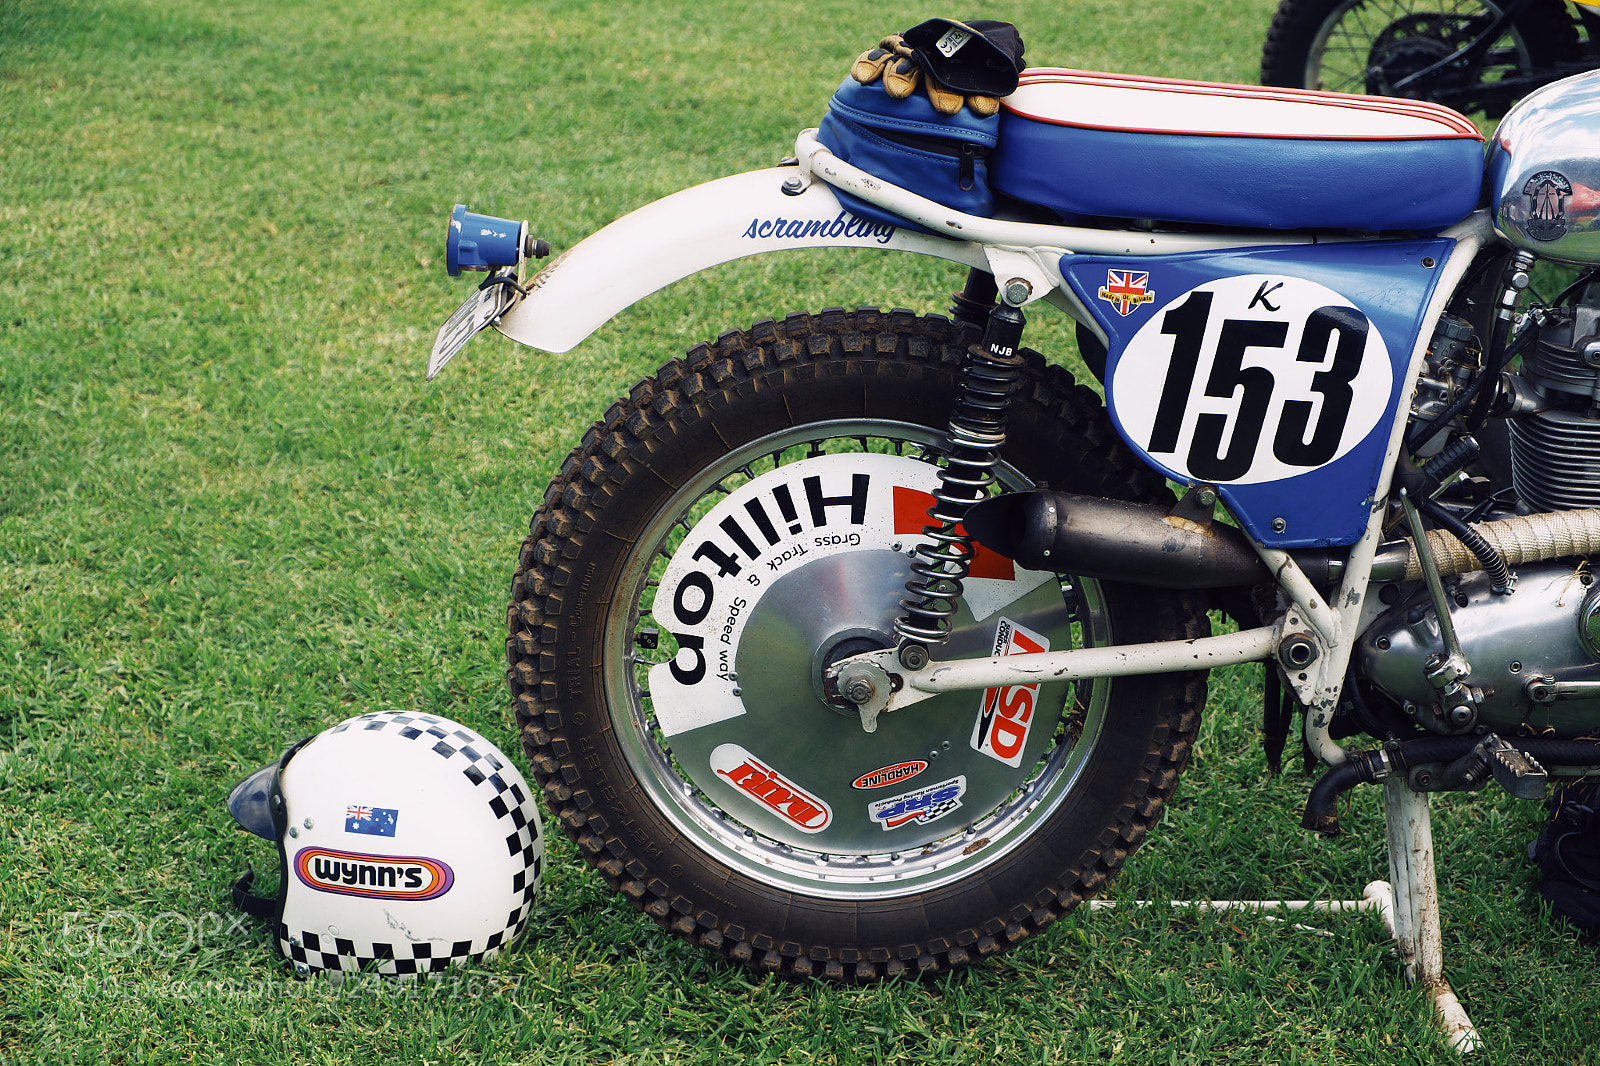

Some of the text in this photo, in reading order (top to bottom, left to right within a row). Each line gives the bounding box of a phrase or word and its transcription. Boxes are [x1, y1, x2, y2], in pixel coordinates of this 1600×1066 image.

[742, 210, 896, 244] scrambling
[1248, 280, 1284, 312] K
[990, 343, 1013, 356] NJB
[1147, 291, 1369, 481] 153
[716, 533, 861, 681] Grass Track & Speed way
[861, 763, 920, 788] HARDLINE
[717, 760, 824, 826] DART
[876, 785, 961, 819] SRP
